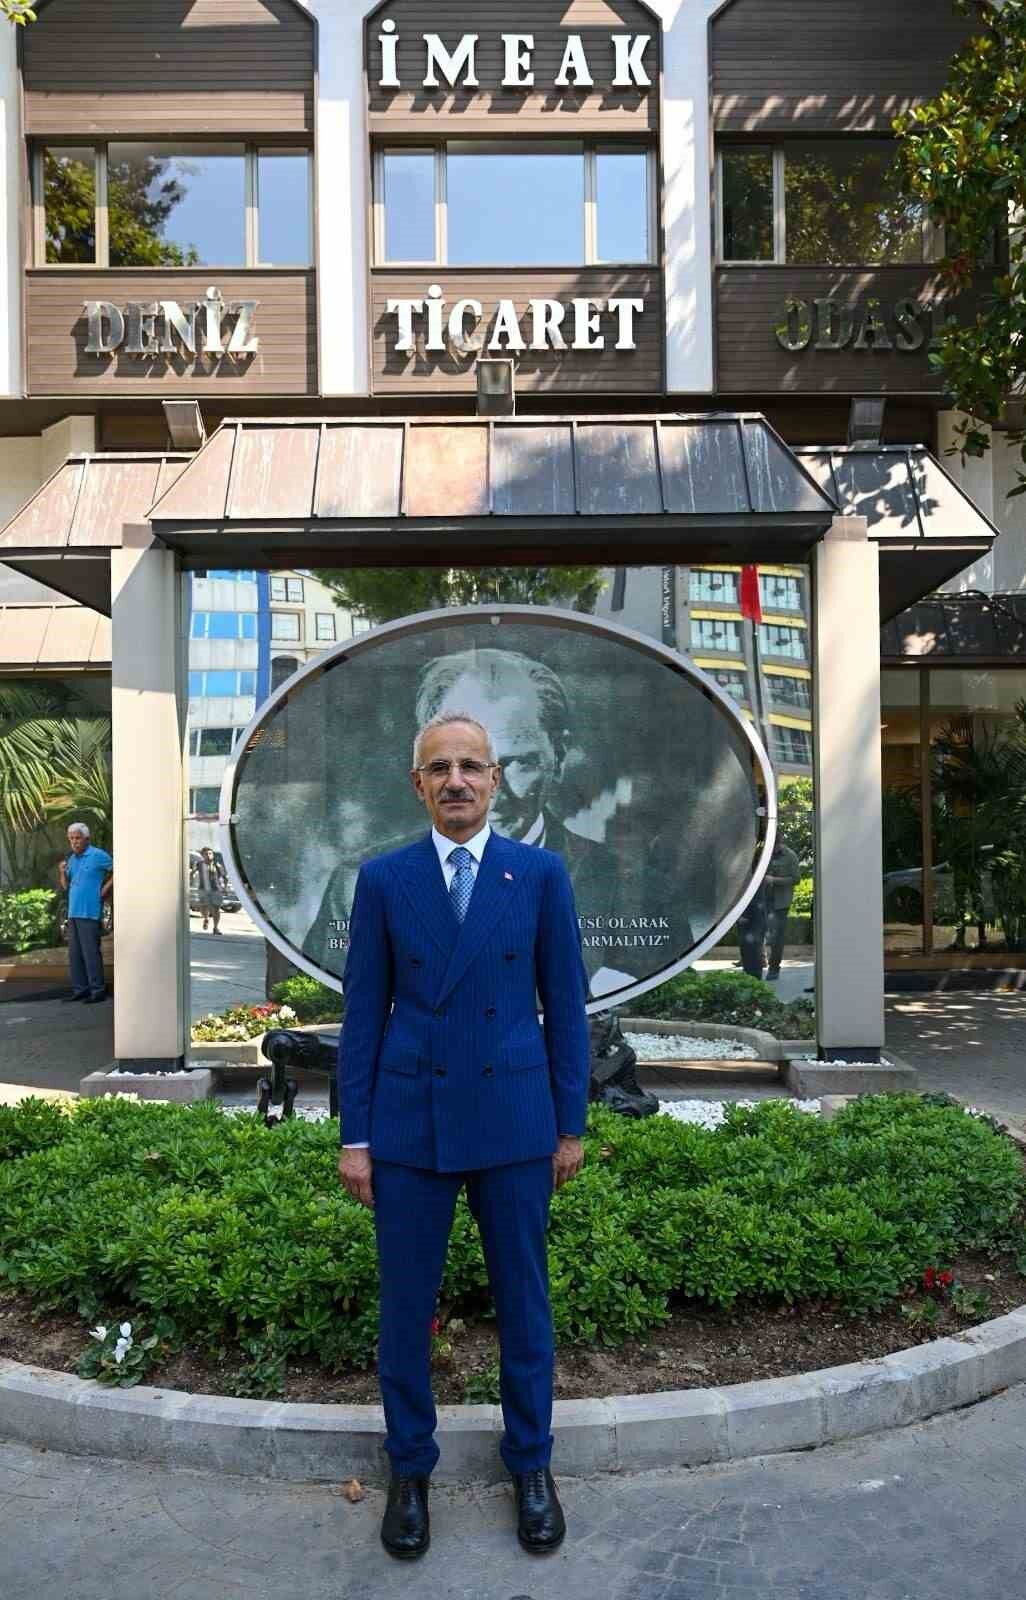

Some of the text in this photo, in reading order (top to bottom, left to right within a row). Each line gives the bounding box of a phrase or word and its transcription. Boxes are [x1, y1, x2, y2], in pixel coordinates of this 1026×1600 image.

[378, 19, 651, 87] İMEAK
[84, 286, 260, 353] DENİZ
[387, 284, 644, 351] TİCARET
[608, 917, 670, 929] OLARAK
